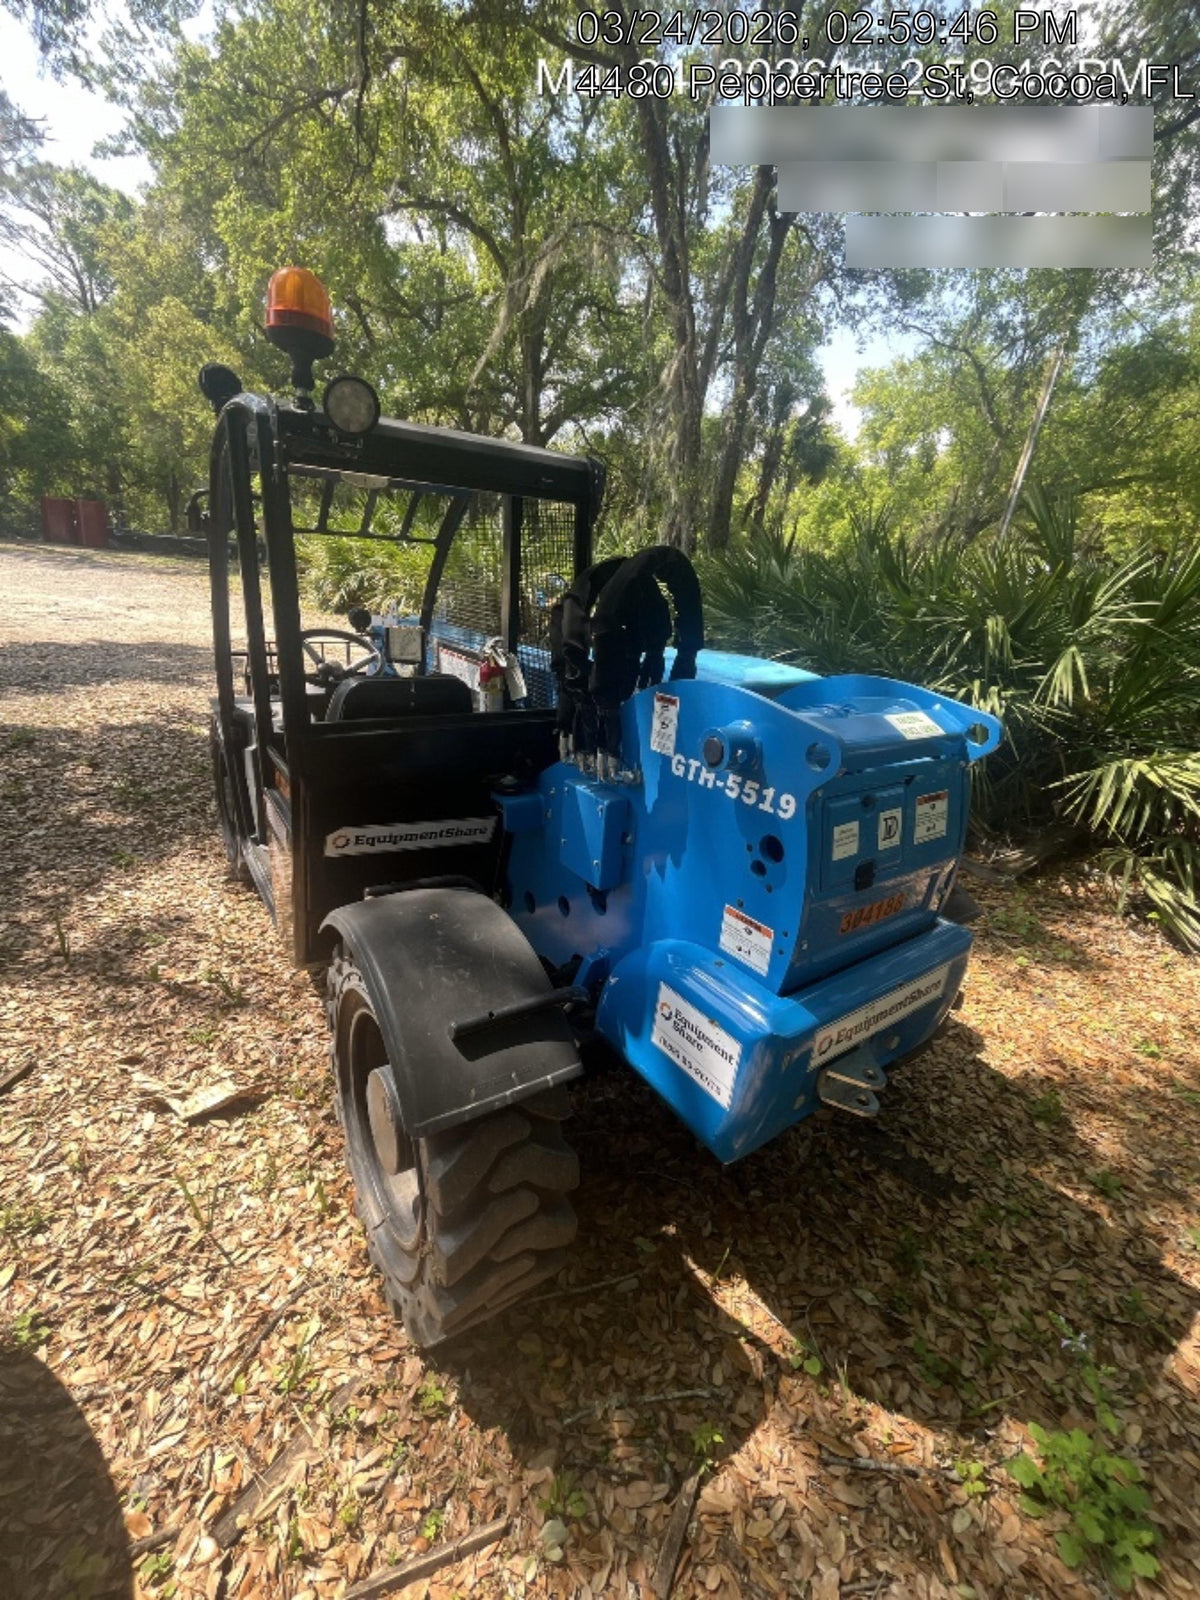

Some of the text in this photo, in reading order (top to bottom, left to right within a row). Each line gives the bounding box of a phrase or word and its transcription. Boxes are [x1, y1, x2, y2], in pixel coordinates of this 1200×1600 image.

[671, 753, 797, 820] GTH-5519
[354, 827, 489, 848] EquipmentShare
[672, 1020, 704, 1053] Share
[674, 1008, 735, 1066] Equipment
[834, 979, 942, 1046] EquipmentShare
